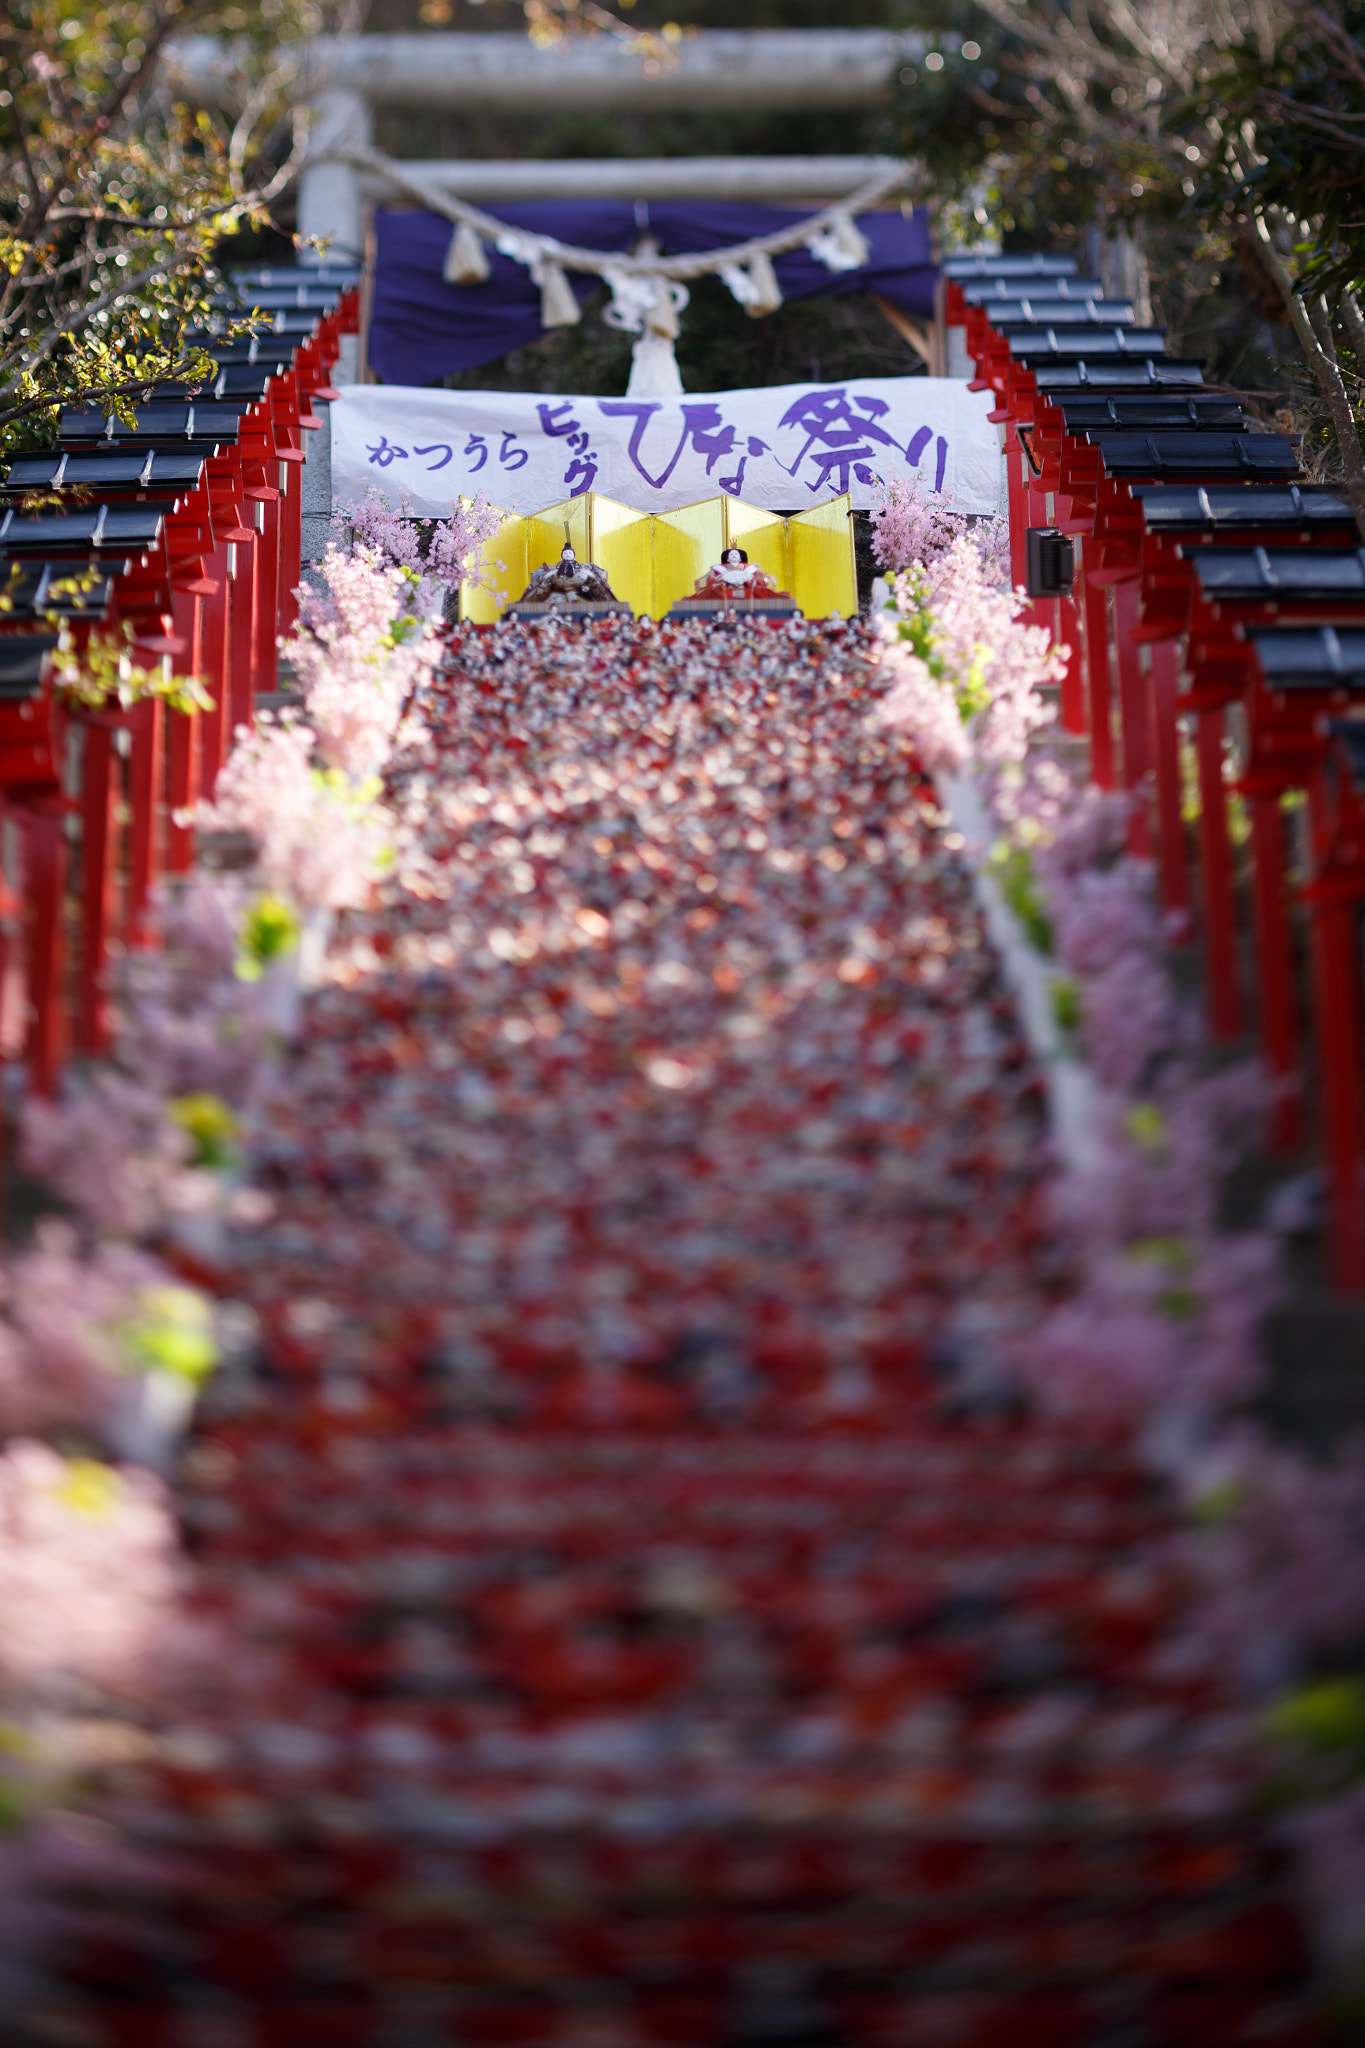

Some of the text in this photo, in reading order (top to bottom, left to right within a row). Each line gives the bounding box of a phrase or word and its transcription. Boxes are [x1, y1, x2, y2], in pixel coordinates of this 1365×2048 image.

[366, 431, 528, 471] かつうら
[599, 389, 948, 495] ひな祭り
